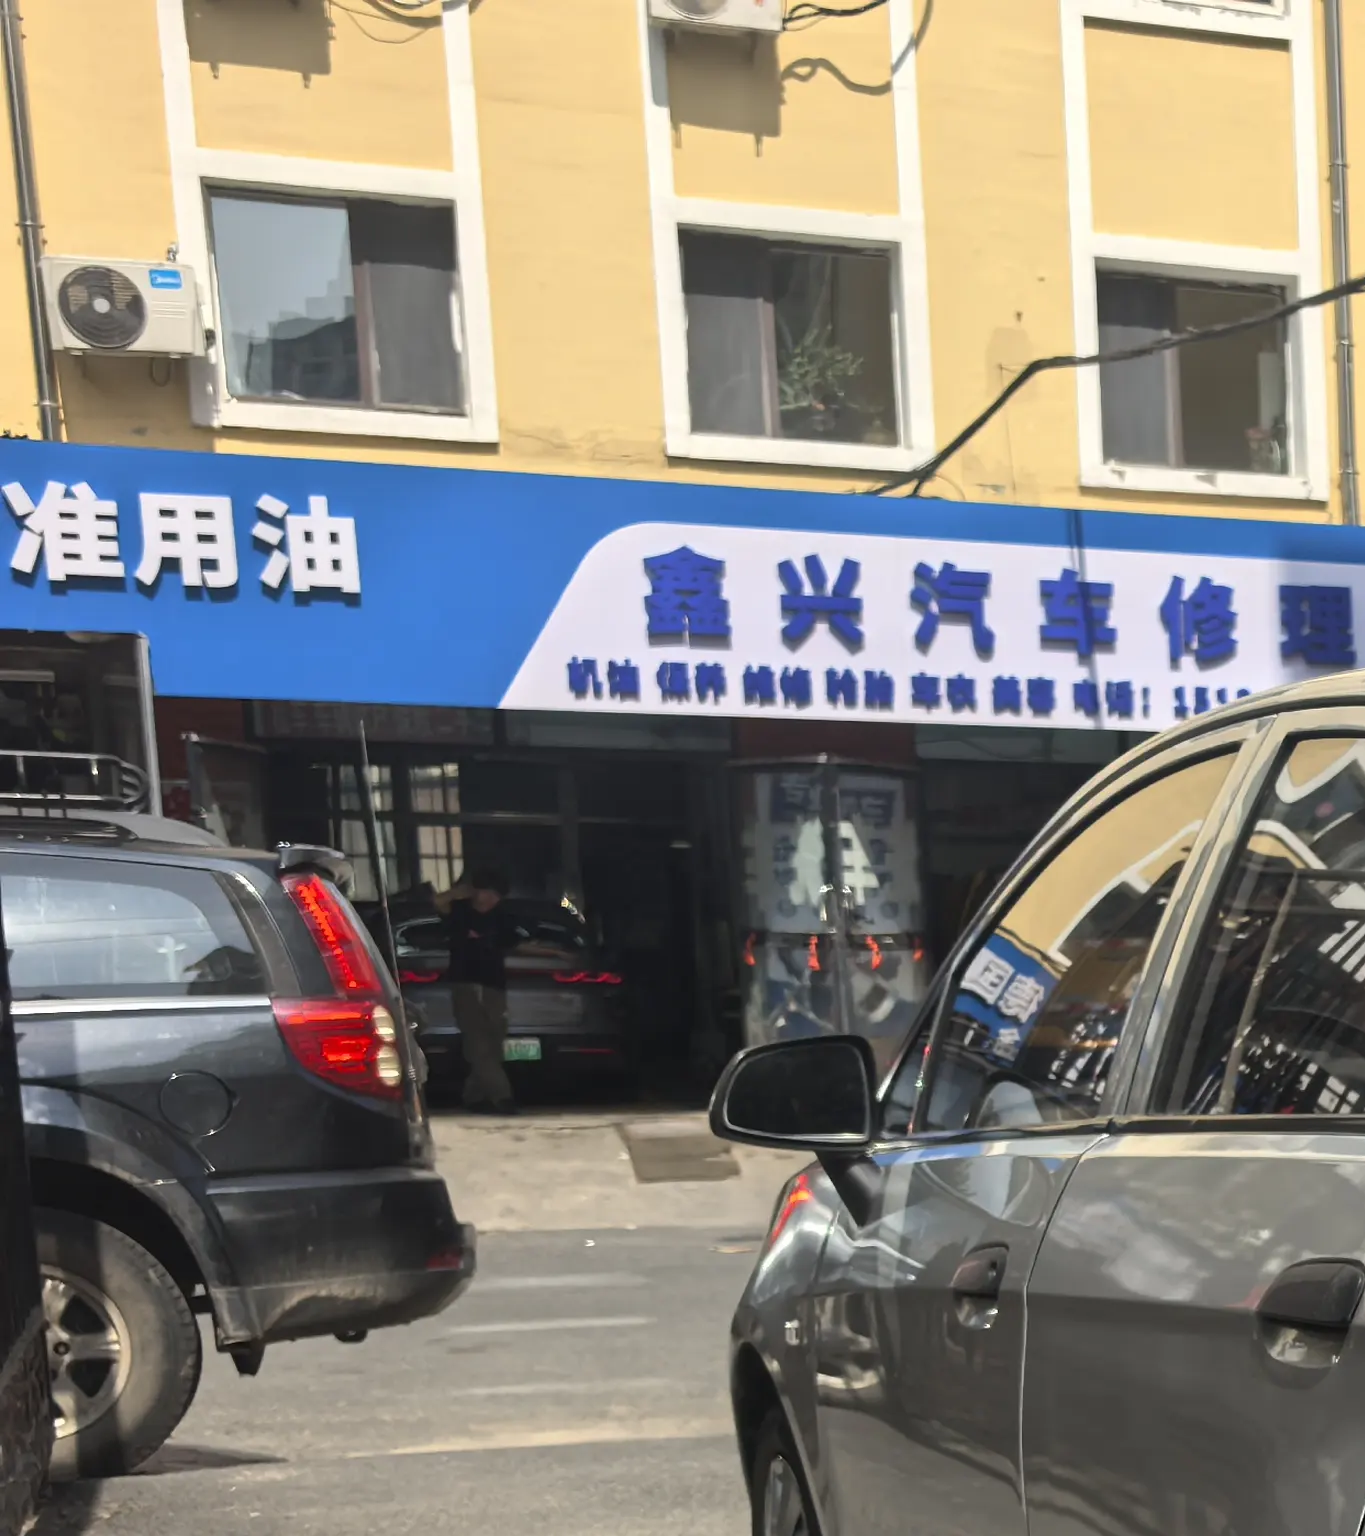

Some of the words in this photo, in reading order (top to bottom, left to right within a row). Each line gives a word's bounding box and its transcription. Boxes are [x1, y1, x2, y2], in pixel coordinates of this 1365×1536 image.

[2, 481, 361, 594] 准用油
[643, 545, 1357, 669] 鑫兴汽车修理
